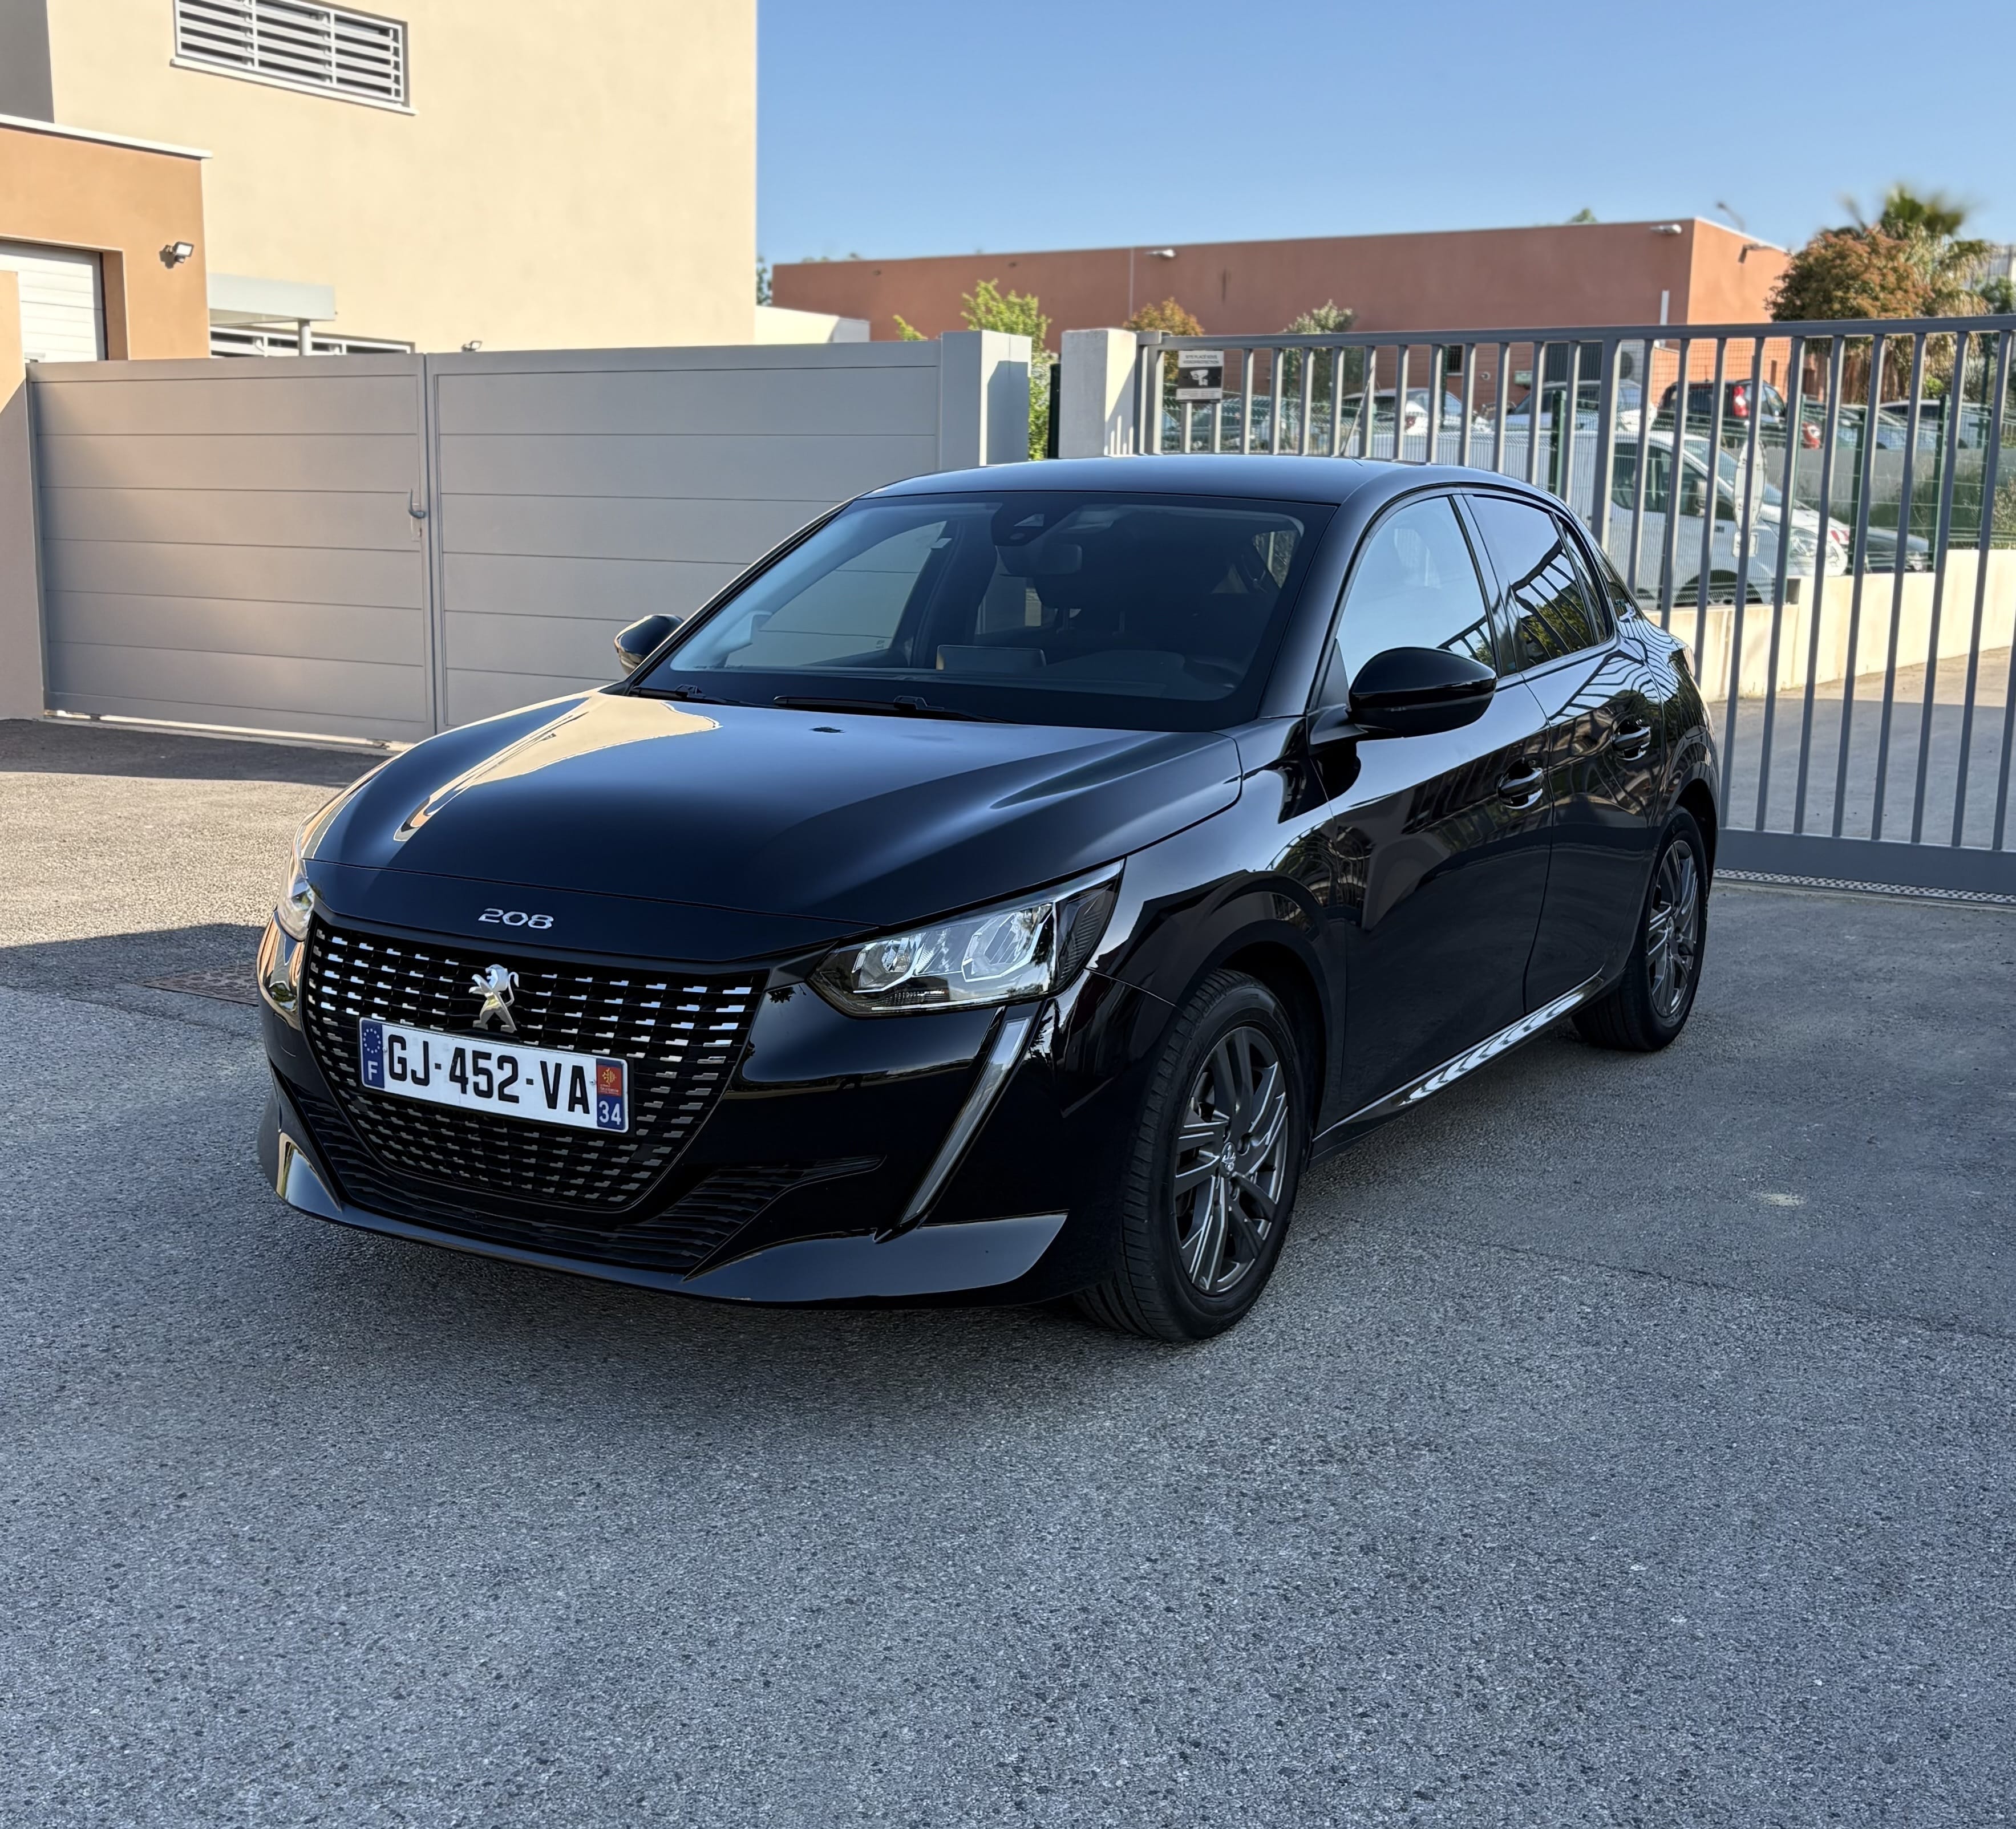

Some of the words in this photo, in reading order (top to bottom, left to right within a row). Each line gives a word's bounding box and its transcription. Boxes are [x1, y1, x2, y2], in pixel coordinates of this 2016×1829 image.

[478, 908, 554, 929] 208
[367, 1061, 379, 1081] F
[388, 1035, 590, 1114] GJ-452-VA
[599, 1101, 621, 1125] 34
